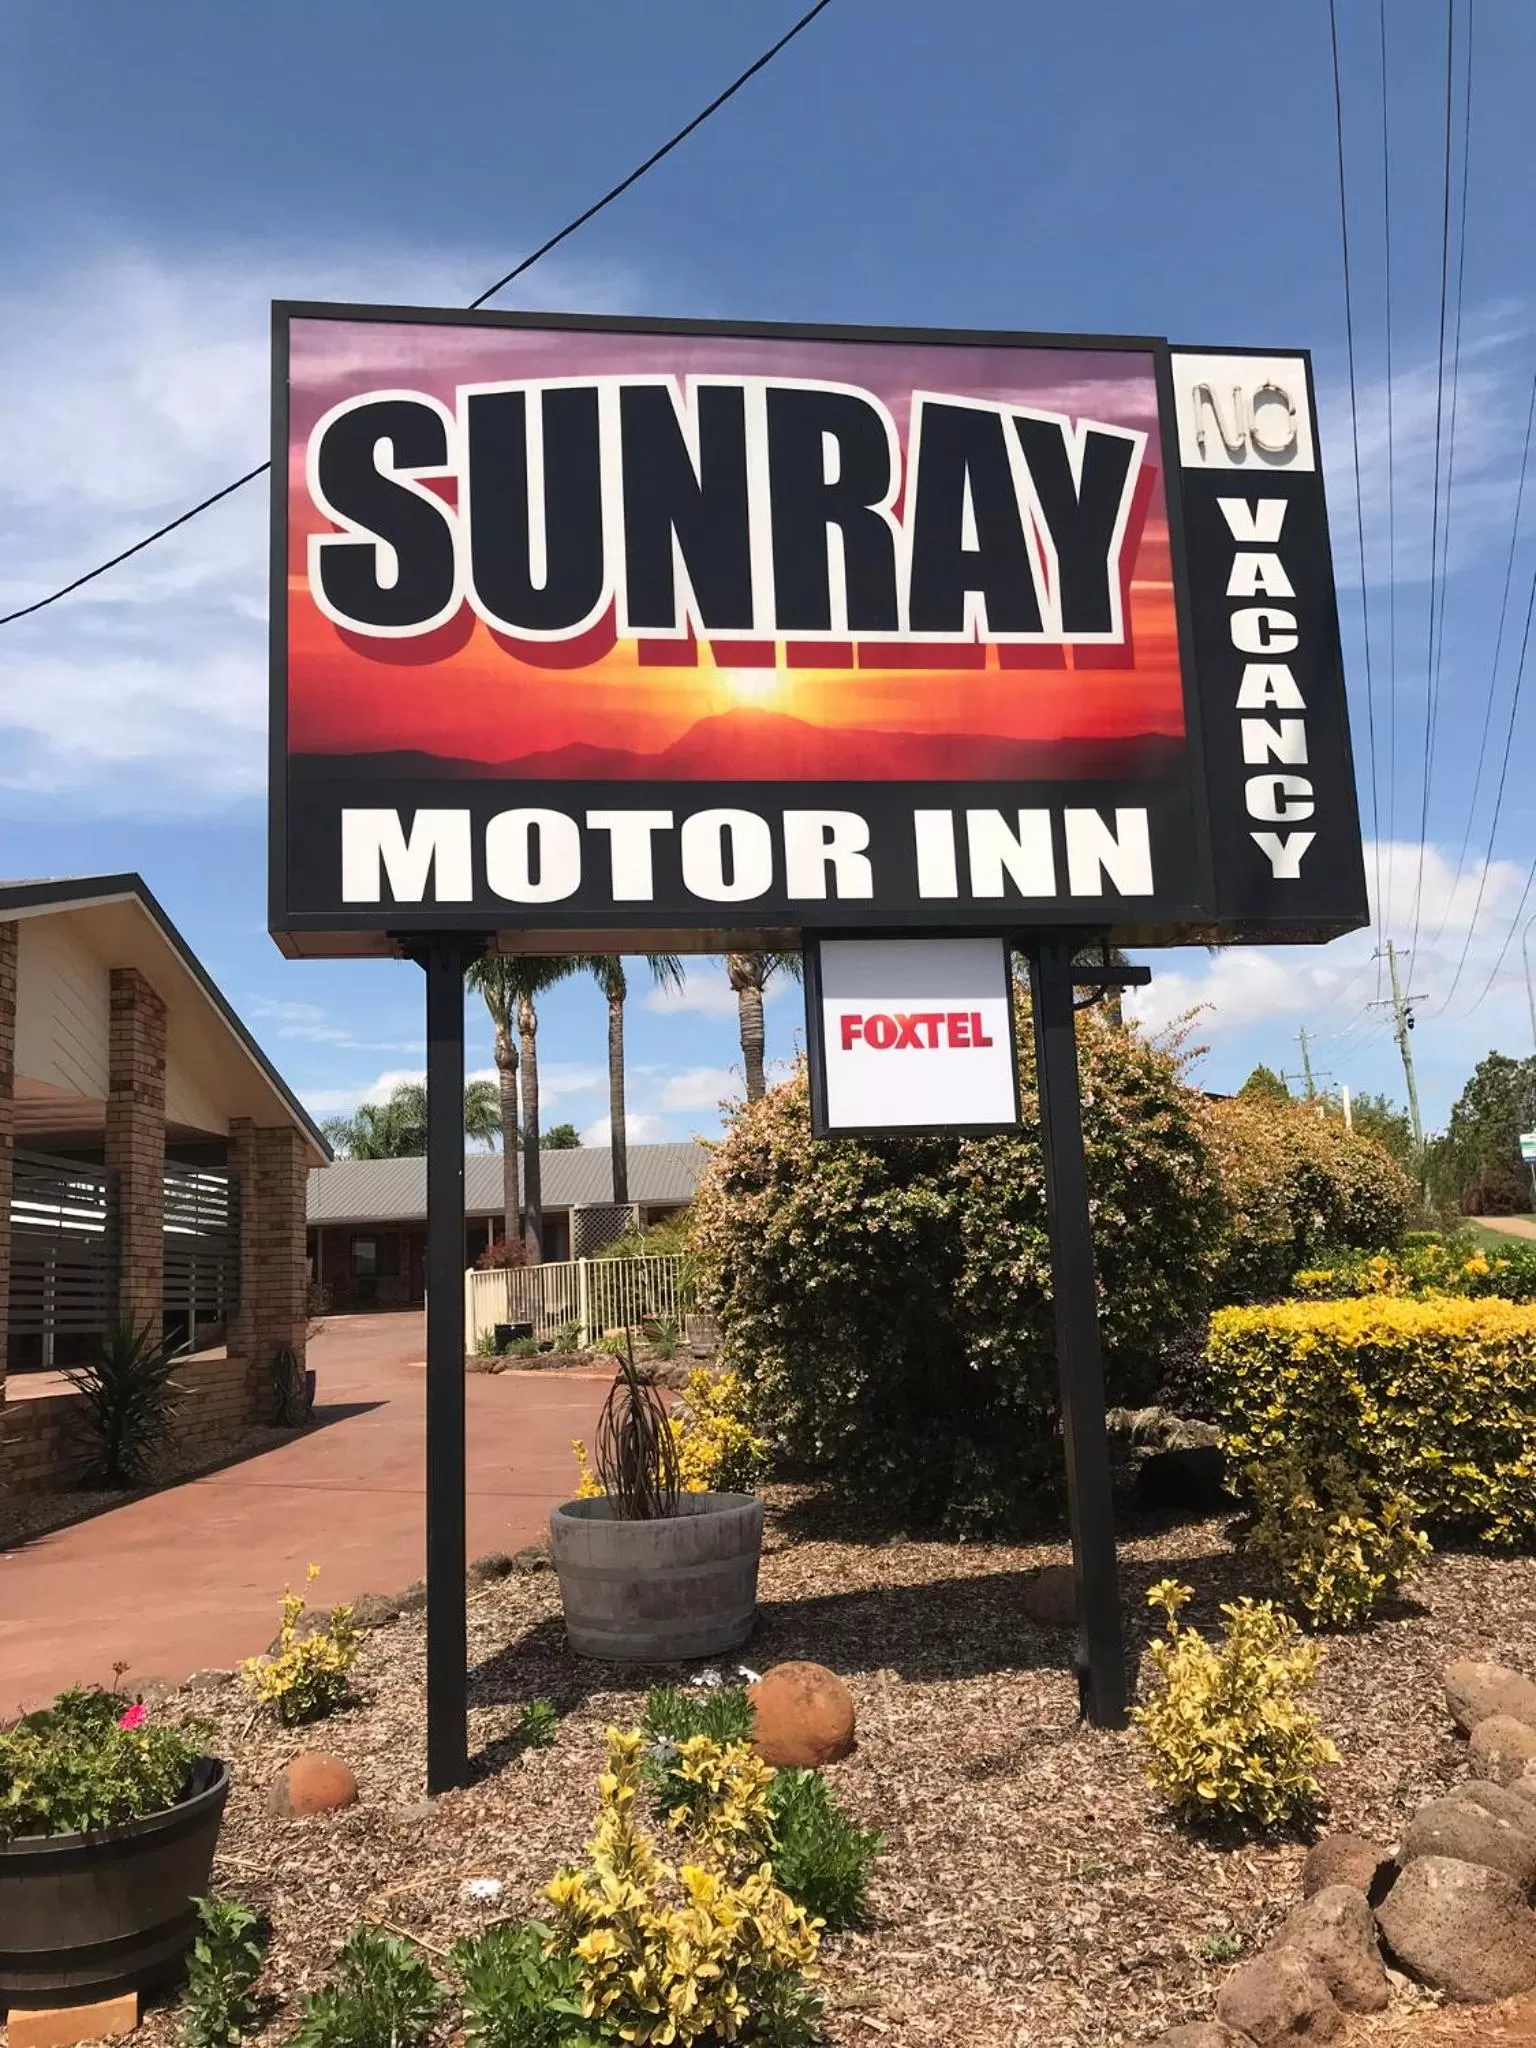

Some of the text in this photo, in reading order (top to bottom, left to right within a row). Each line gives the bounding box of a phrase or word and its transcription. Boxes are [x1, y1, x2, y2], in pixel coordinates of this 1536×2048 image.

[1191, 381, 1298, 460] NO
[307, 373, 1148, 645] SUNRAY
[1216, 497, 1317, 879] VACANCY
[341, 806, 1155, 904] MOTOR INN
[840, 1011, 993, 1050] FOXTEL
